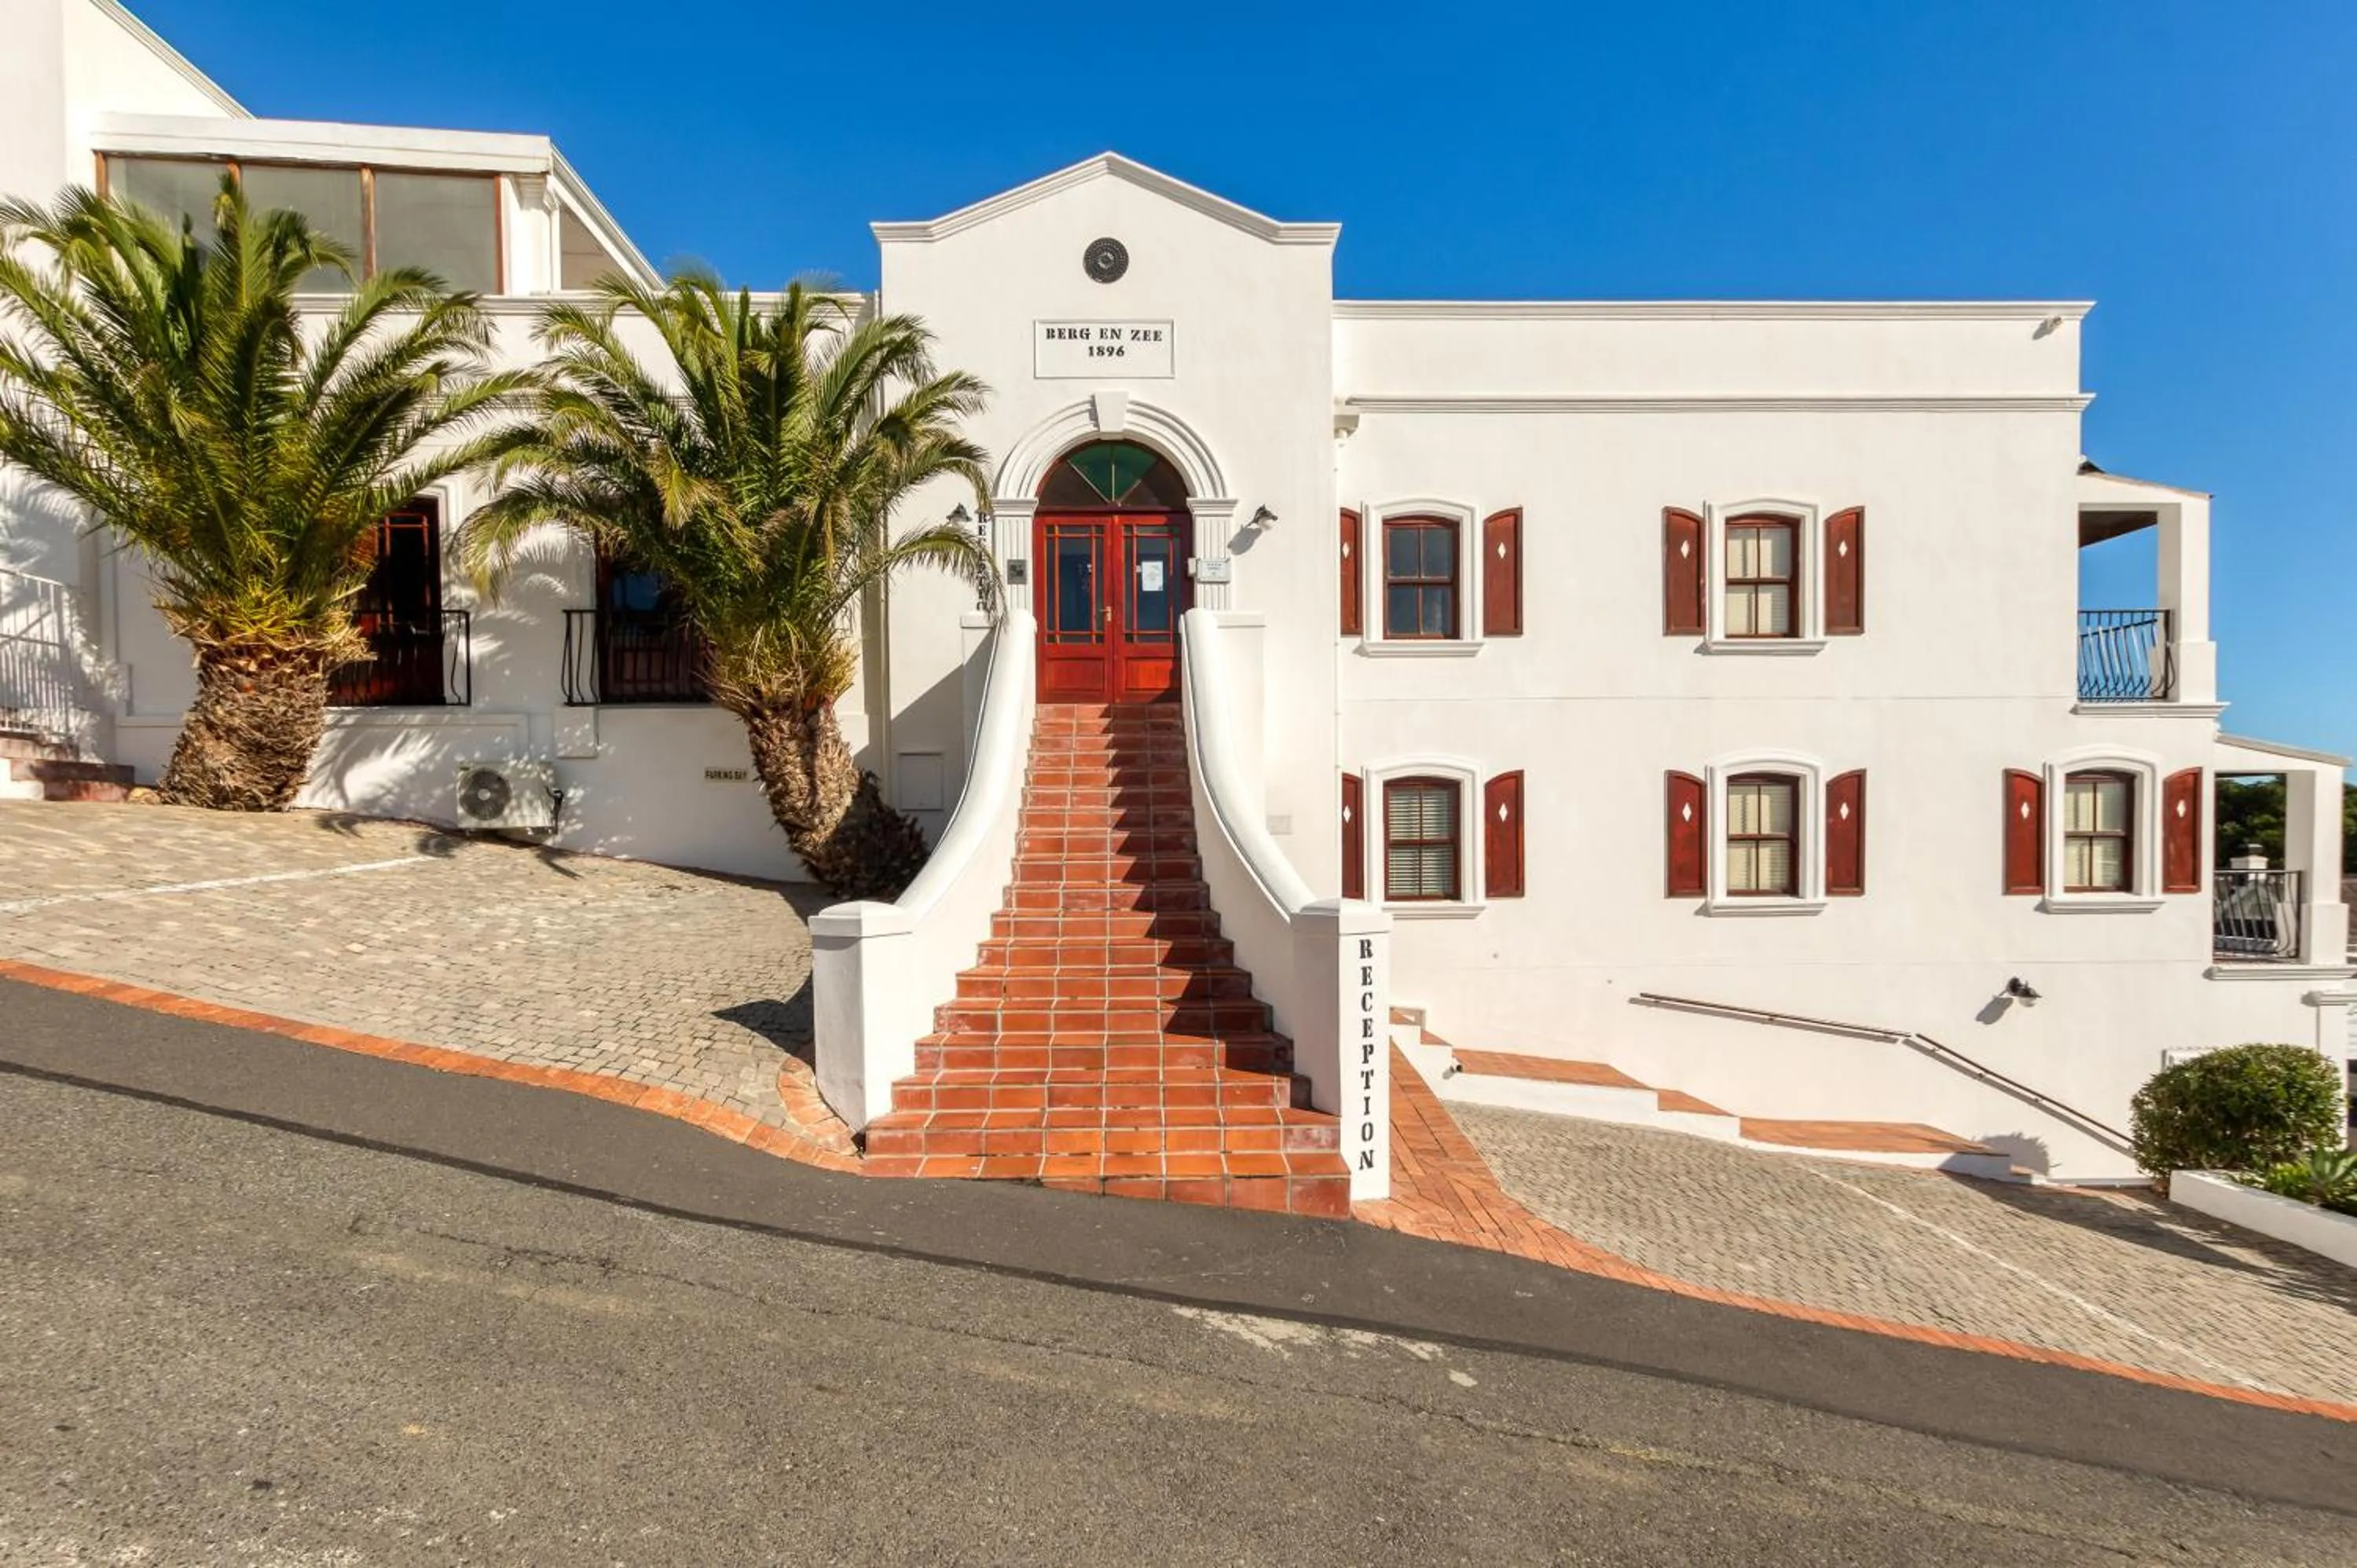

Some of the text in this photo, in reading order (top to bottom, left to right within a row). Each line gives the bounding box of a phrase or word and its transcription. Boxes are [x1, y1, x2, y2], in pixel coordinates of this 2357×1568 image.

[1046, 328, 1162, 341] BERG EN ZEE
[1088, 346, 1125, 357] 1896
[1358, 939, 1374, 1171] RECEPTION
